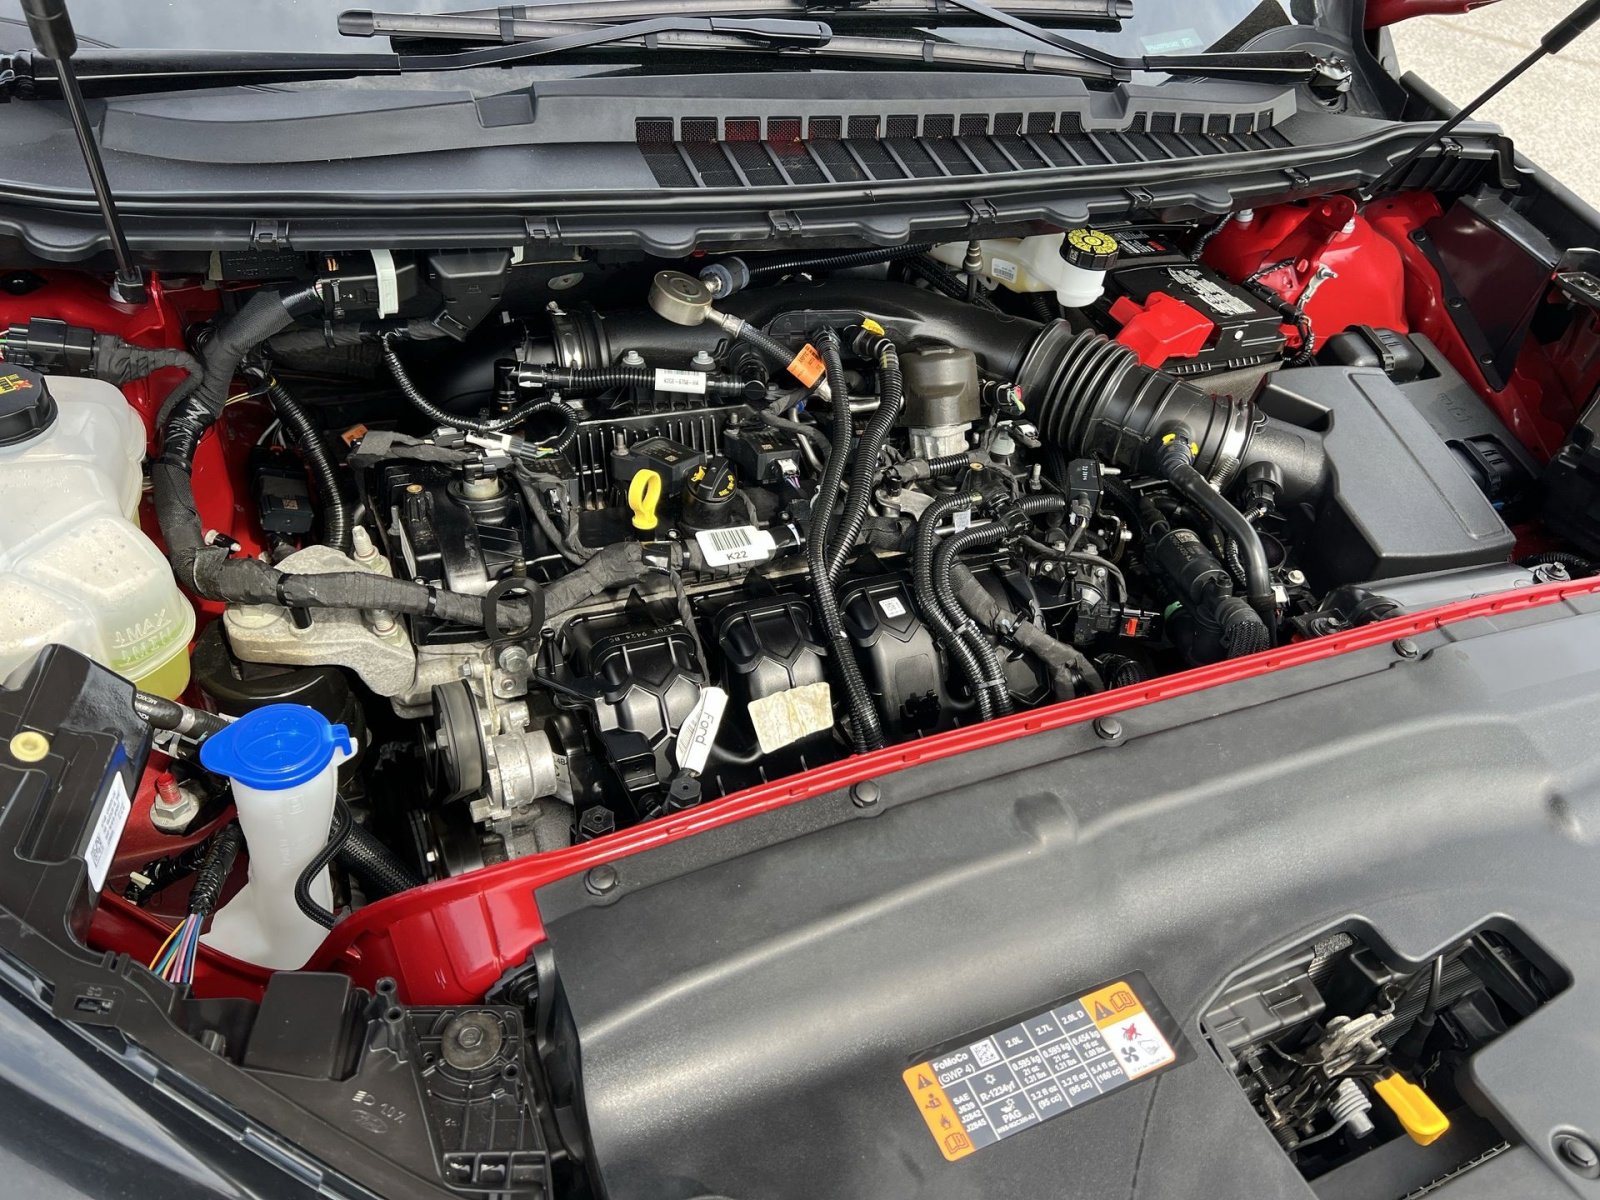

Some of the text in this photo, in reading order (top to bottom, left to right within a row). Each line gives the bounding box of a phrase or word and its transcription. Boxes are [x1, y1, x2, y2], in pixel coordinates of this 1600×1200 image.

[726, 550, 748, 560] K22
[126, 608, 166, 640] MAX
[695, 711, 714, 746] Ford
[1035, 1024, 1053, 1036] 2.7L
[1089, 1030, 1100, 1039] kg
[1005, 1036, 1023, 1048] 2.0L
[1060, 1042, 1072, 1052] kg
[932, 1052, 969, 1072] FoMoCo
[1030, 1054, 1042, 1064] kg
[938, 1063, 976, 1086] (GWP 4)
[979, 1080, 1016, 1102] R-1234yf
[953, 1092, 971, 1105] SAE
[1002, 1109, 1022, 1123] PAG
